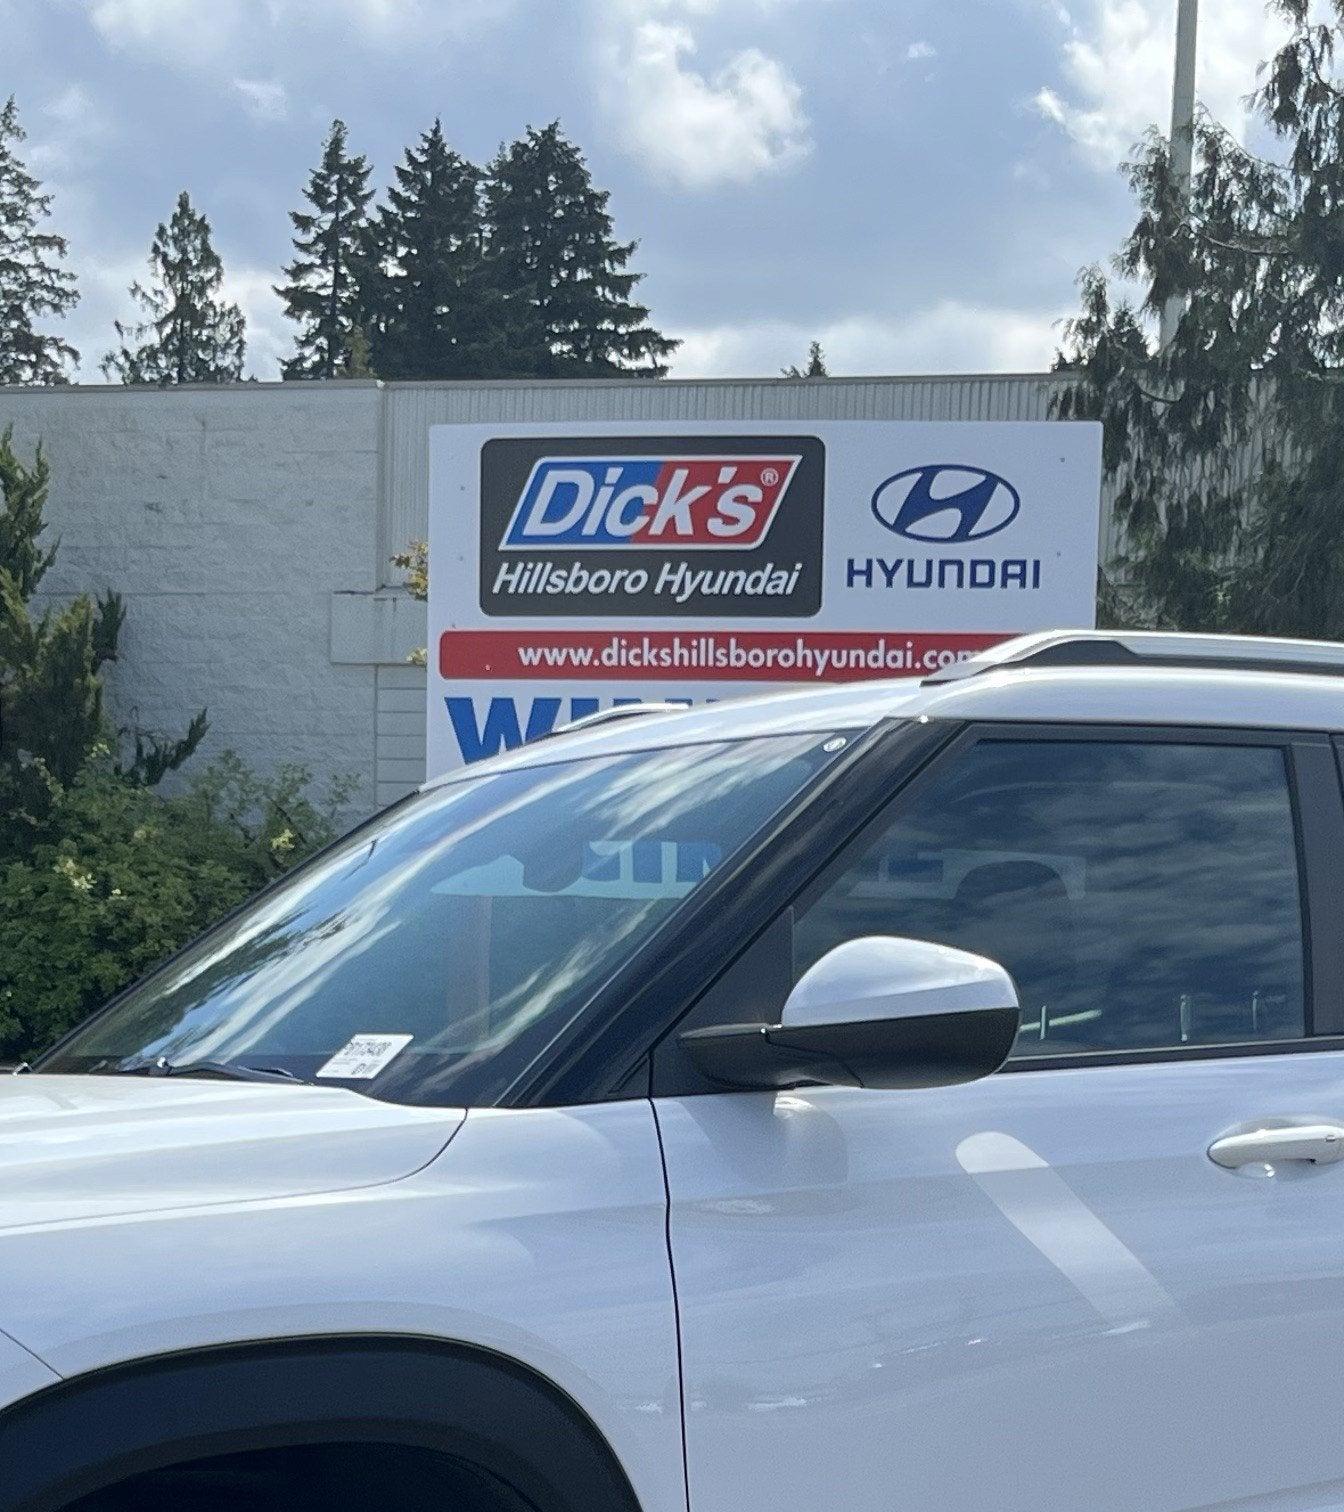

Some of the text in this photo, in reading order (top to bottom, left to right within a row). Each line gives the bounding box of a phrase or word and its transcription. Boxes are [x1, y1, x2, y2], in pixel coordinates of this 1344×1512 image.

[492, 562, 803, 603] Hillsboro Hyundai
[846, 558, 1040, 590] HYUNDAI
